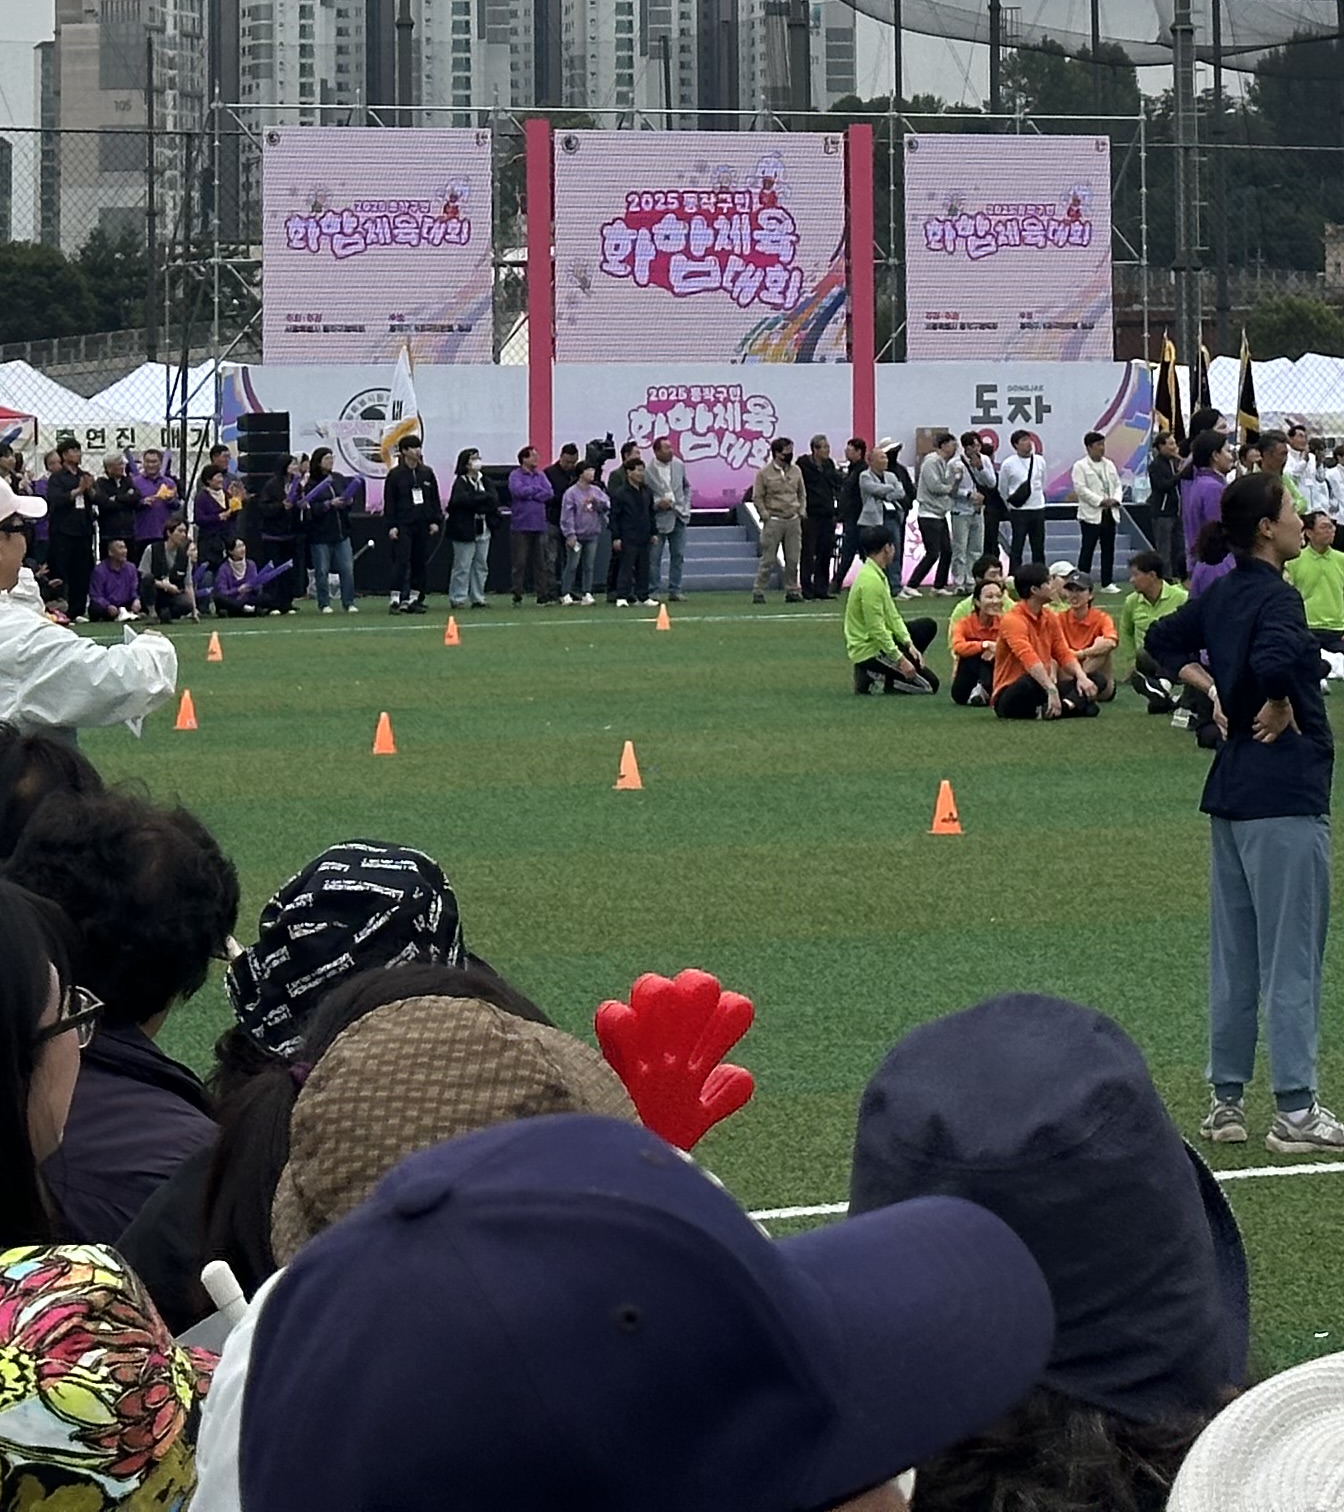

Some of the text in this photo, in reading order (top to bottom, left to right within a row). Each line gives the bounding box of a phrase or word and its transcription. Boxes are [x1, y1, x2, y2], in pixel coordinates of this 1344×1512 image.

[113, 98, 133, 113] 105
[625, 189, 751, 214] 2025 동작구민
[647, 383, 743, 402] 2025 동작구민
